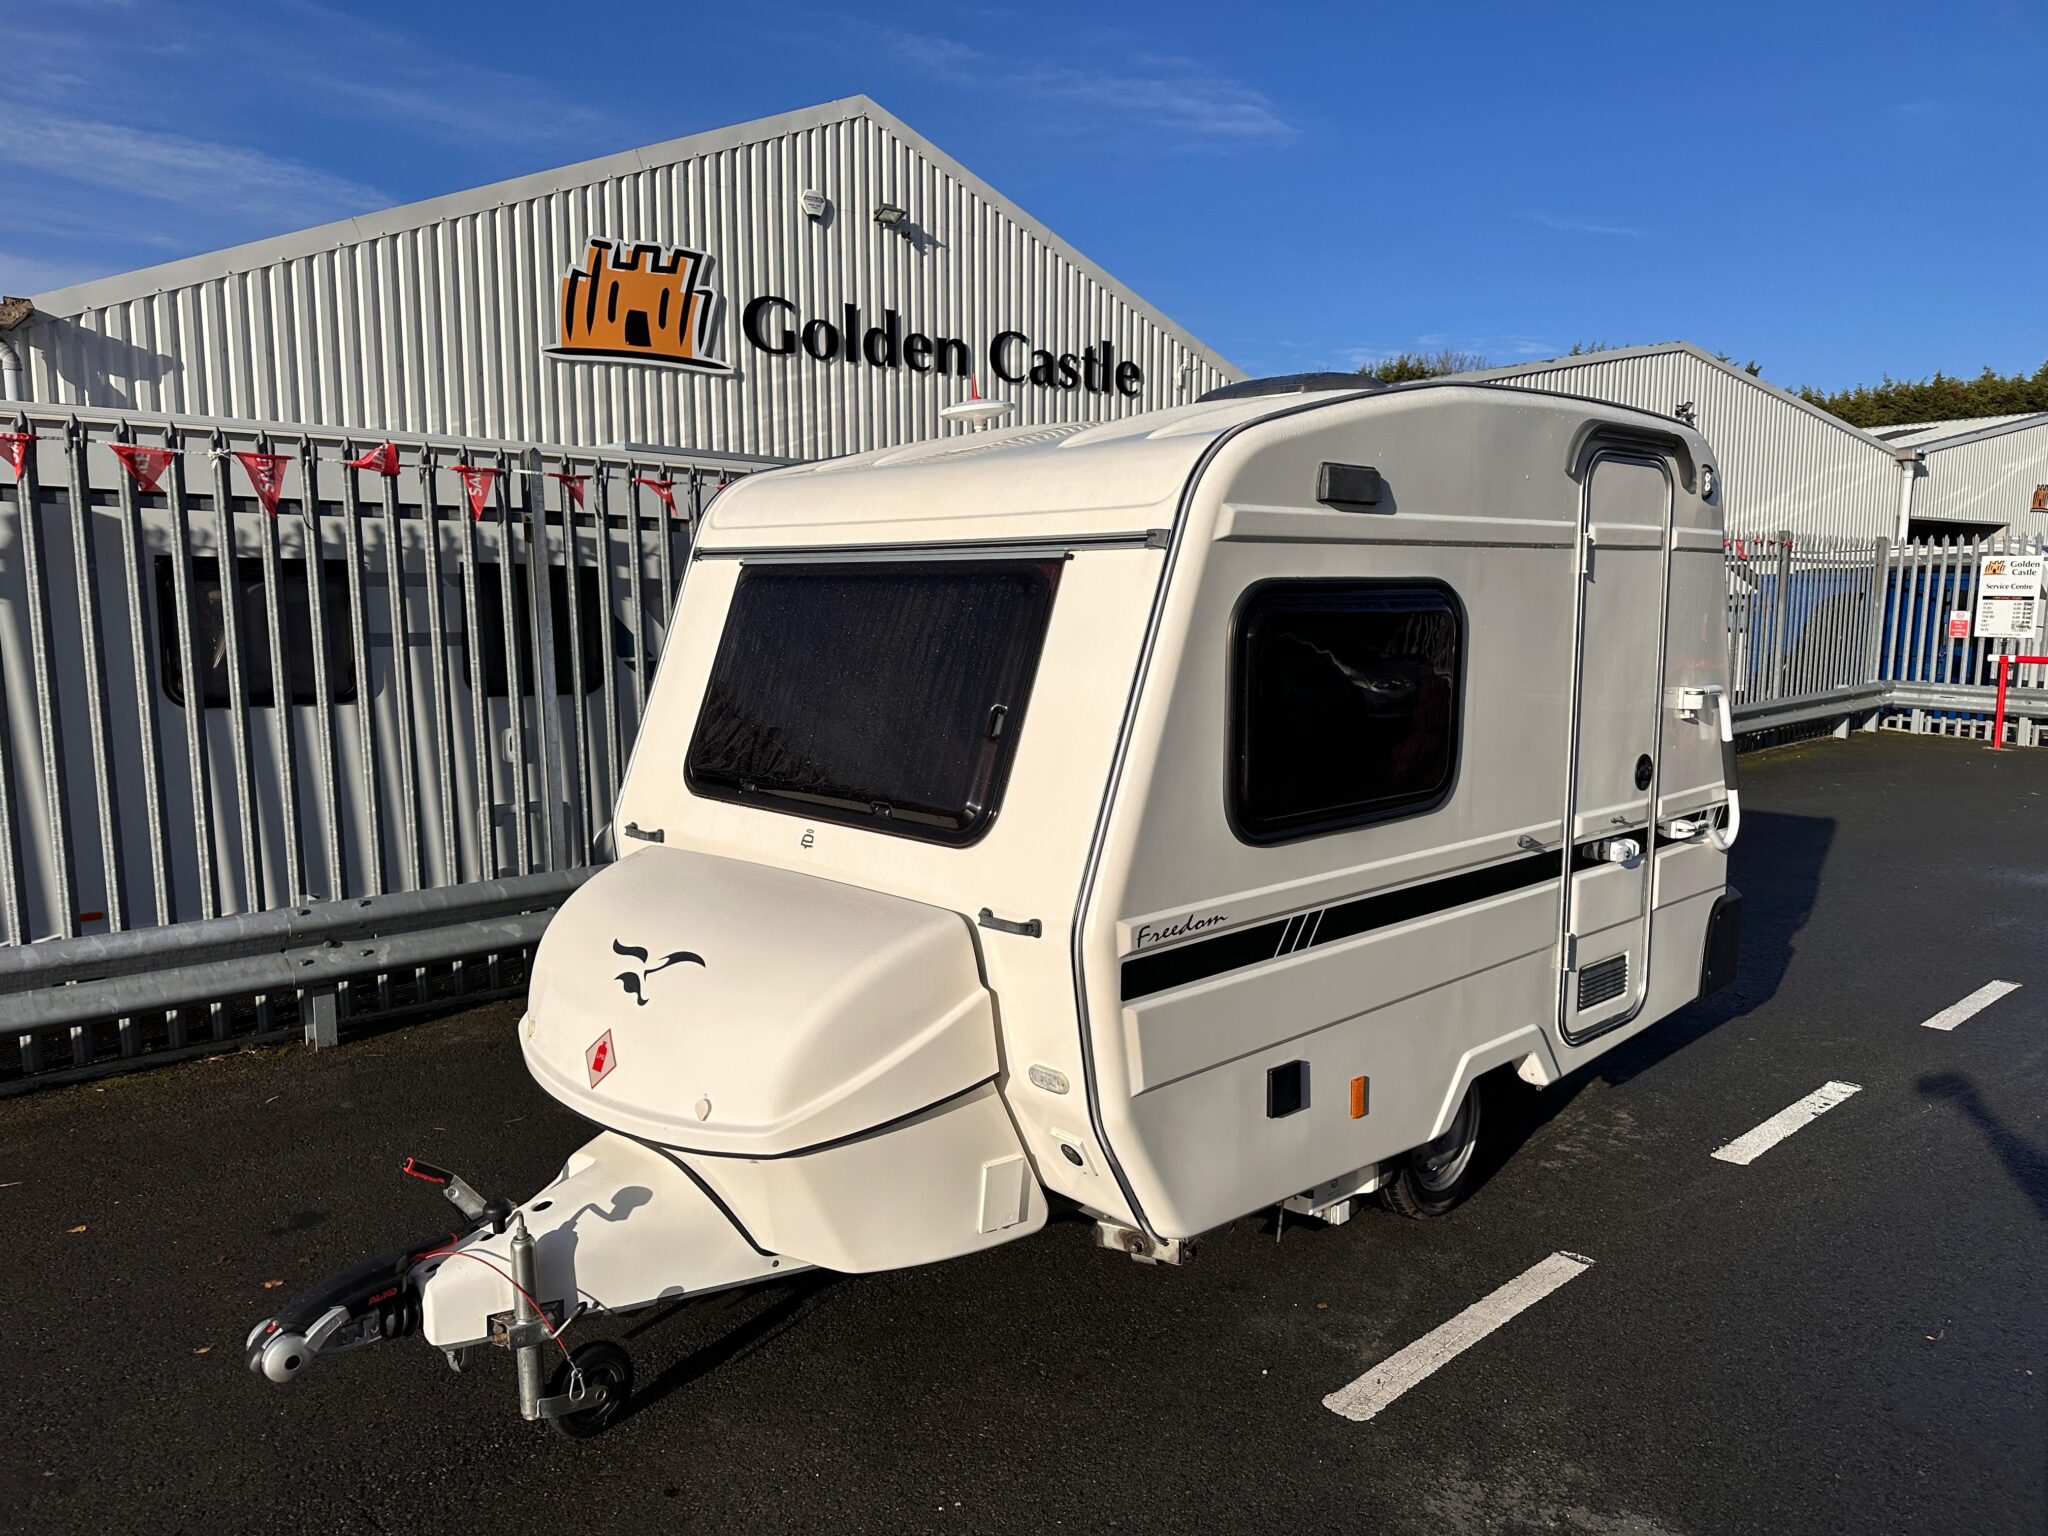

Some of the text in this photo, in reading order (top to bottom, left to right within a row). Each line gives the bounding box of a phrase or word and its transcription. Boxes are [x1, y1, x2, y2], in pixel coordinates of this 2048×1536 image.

[743, 295, 1141, 397] Golden Castle
[2011, 568, 2037, 576] Castle
[1136, 913, 1230, 949] Freedom
